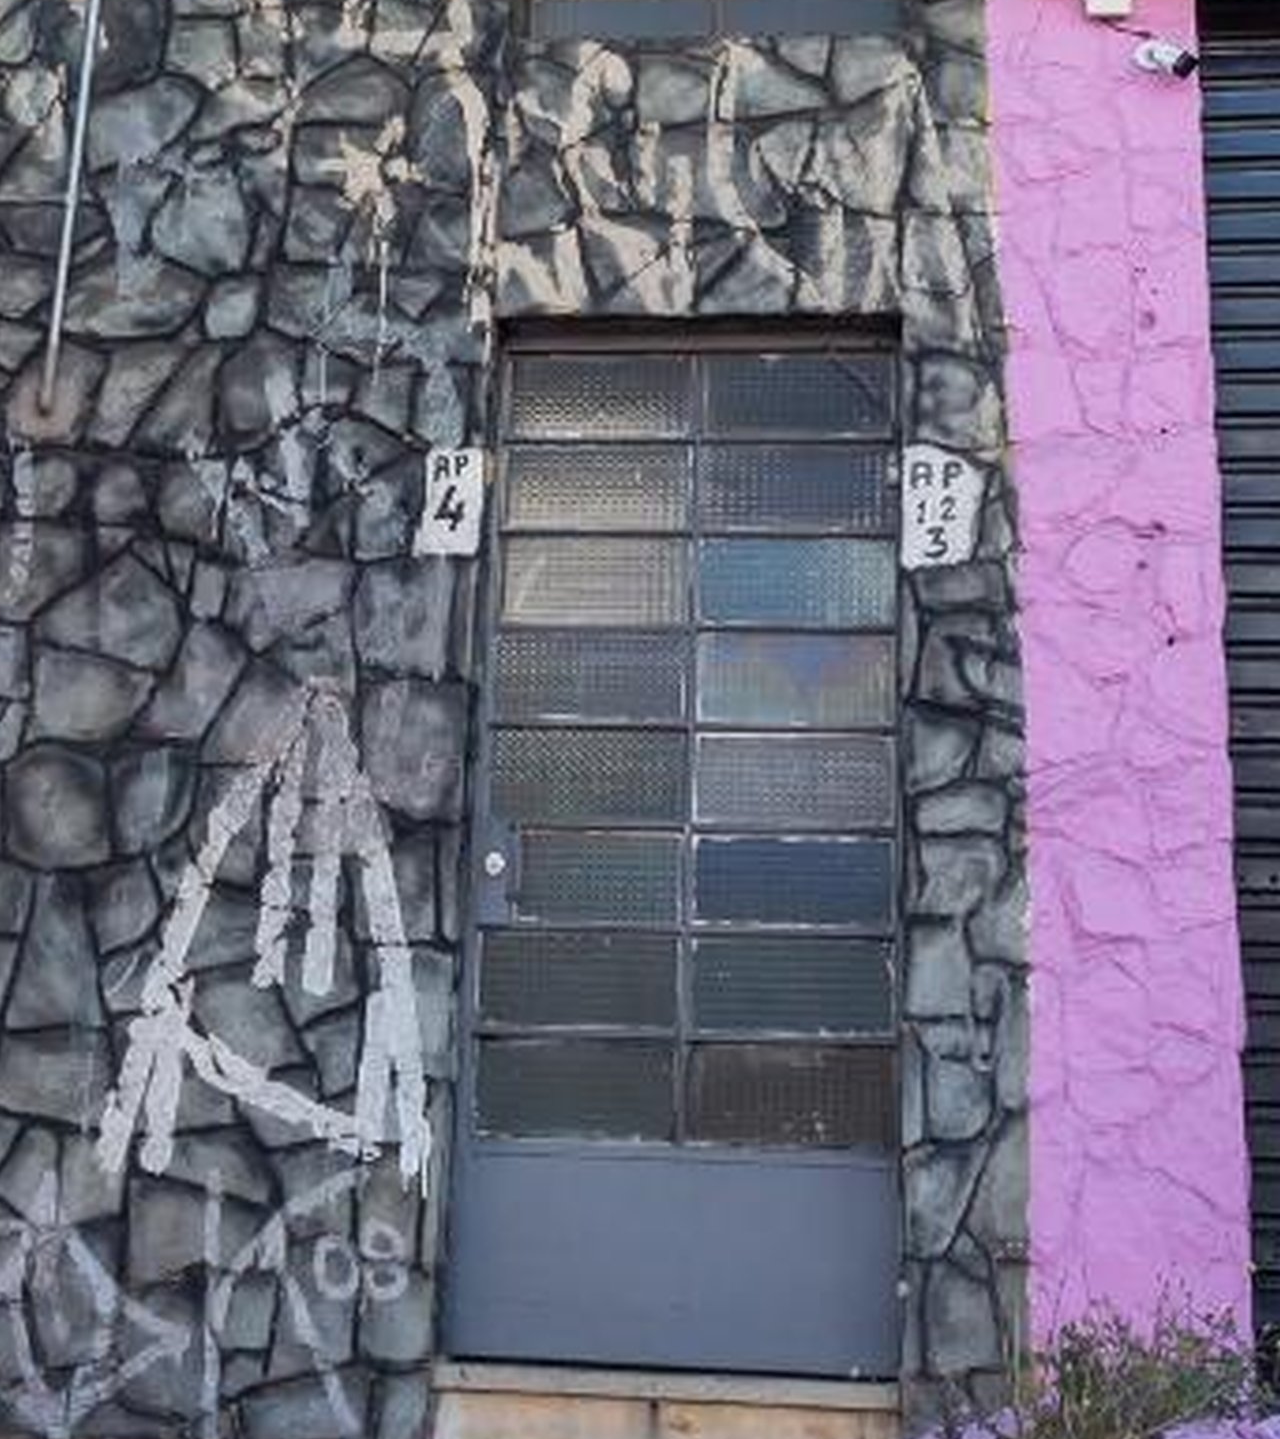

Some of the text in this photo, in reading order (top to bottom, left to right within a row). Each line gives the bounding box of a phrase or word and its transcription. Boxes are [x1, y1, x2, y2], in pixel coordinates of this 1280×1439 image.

[434, 454, 469, 483] AP
[909, 461, 963, 490] AP
[433, 484, 465, 532] 4
[924, 525, 950, 559] 3
